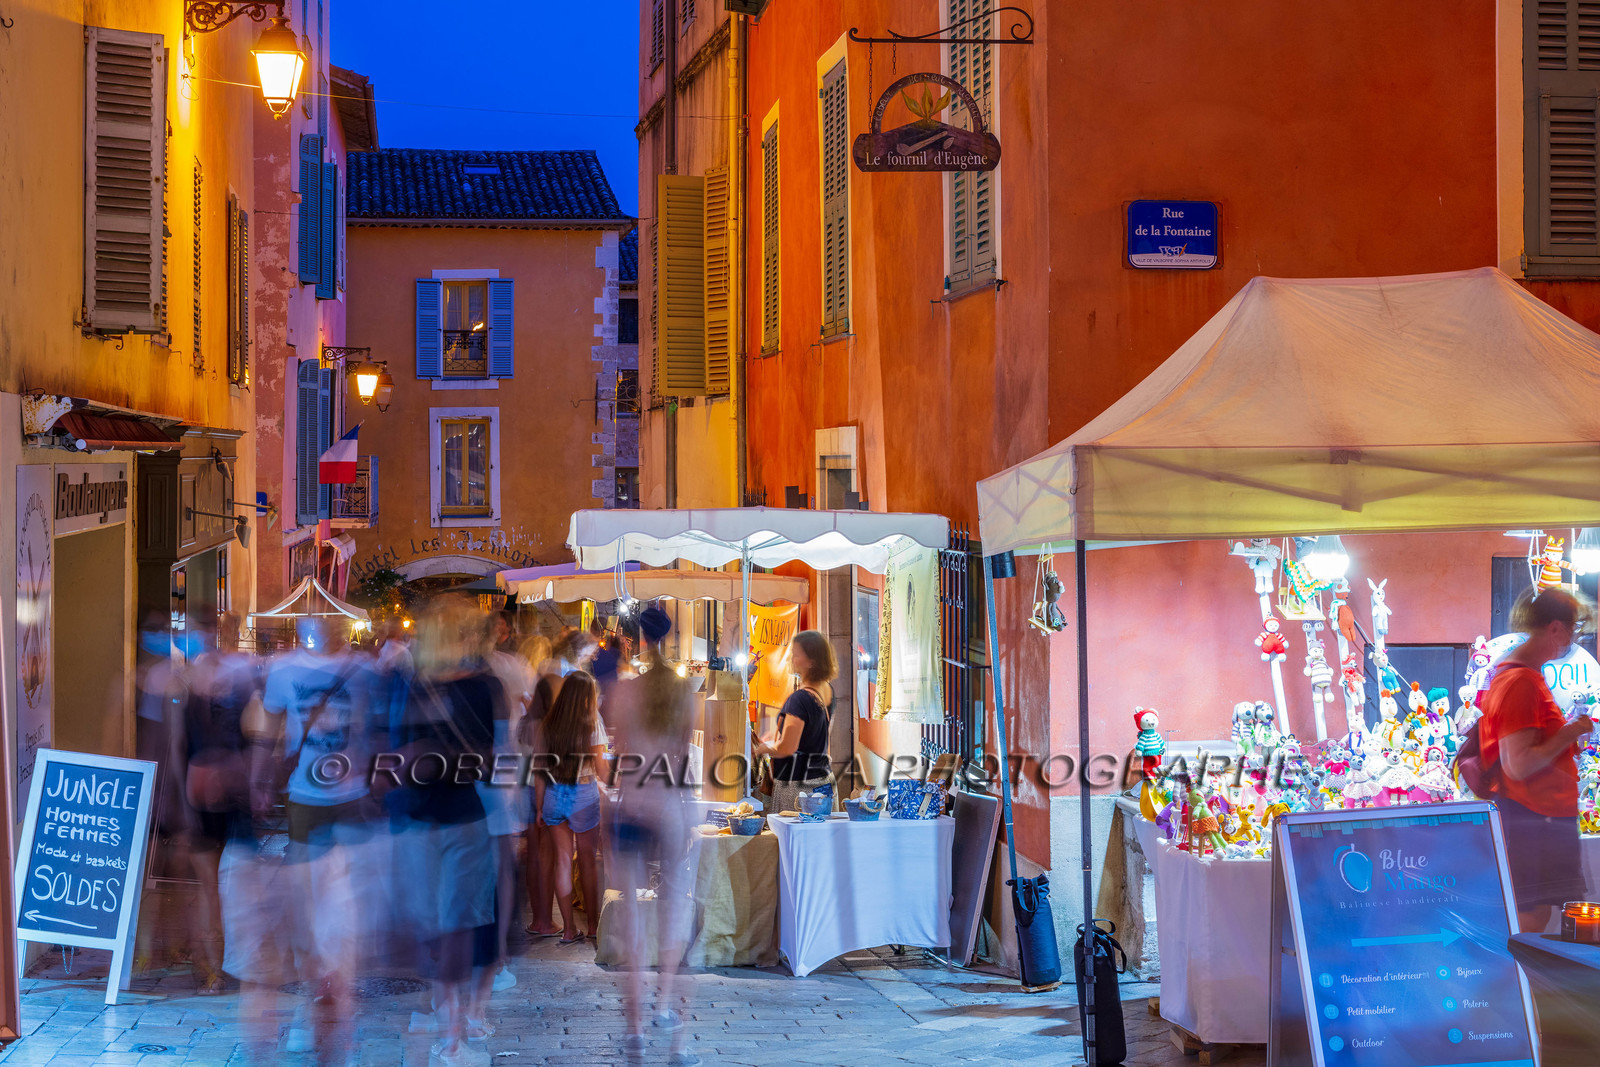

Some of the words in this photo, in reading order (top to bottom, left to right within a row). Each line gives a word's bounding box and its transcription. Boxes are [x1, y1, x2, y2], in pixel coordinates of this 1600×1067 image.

[865, 151, 881, 166] Le
[887, 151, 928, 166] fournil
[934, 151, 988, 170] d'Eugène
[1162, 207, 1185, 219] Rue
[1135, 224, 1148, 236] de
[1150, 224, 1161, 236] la
[1163, 225, 1212, 237] Fontaine
[55, 470, 128, 524] Boulangerie
[409, 536, 441, 556] Les
[46, 769, 136, 810] JUNGLE
[45, 806, 121, 831] HOMMES
[43, 822, 122, 846] FEMMES
[35, 842, 69, 859] Mode
[70, 852, 82, 863] et
[85, 853, 127, 870] baskets
[1379, 848, 1429, 870] Blue
[31, 864, 120, 913] SOLDES
[1384, 871, 1457, 893] Mango
[1339, 900, 1391, 909] Balinese
[1397, 895, 1460, 905] handicraft
[1341, 974, 1382, 984] Décoration
[1456, 966, 1483, 978] Bijoux
[1346, 1006, 1364, 1016] Petit
[1365, 1005, 1396, 1015] mobilier
[1462, 999, 1489, 1009] Poterie
[1351, 1037, 1385, 1049] Outdoor
[1468, 1030, 1514, 1043] Suspensions
